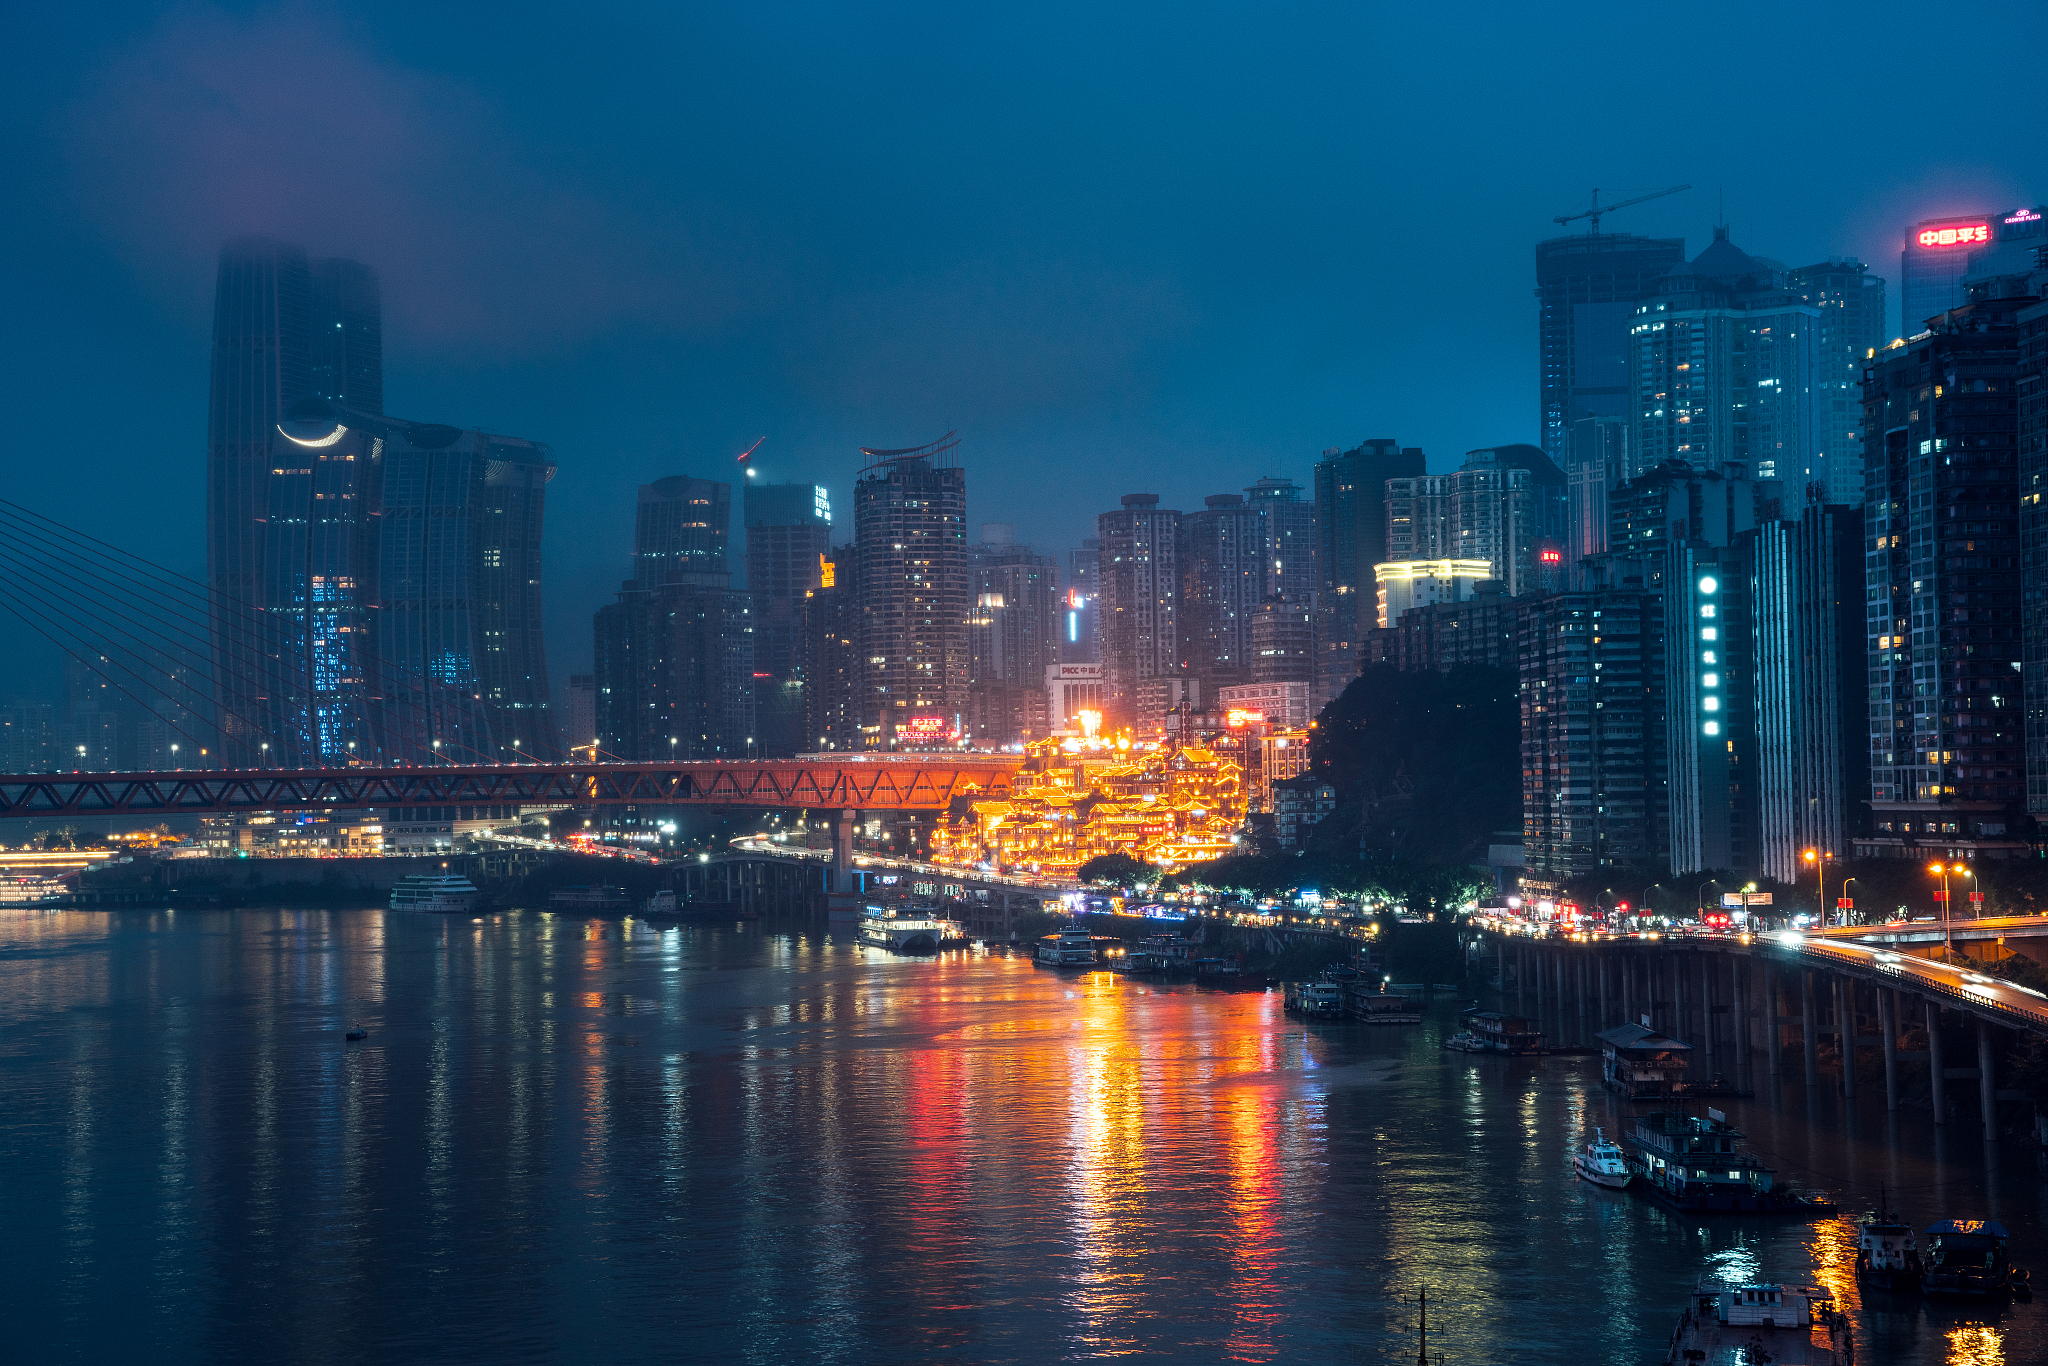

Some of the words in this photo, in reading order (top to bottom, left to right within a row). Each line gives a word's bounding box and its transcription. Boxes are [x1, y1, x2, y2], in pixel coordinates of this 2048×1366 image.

[2004, 216, 2025, 224] CROWNE
[1062, 666, 1079, 675] PICC
[1080, 666, 1103, 675] 中国人
